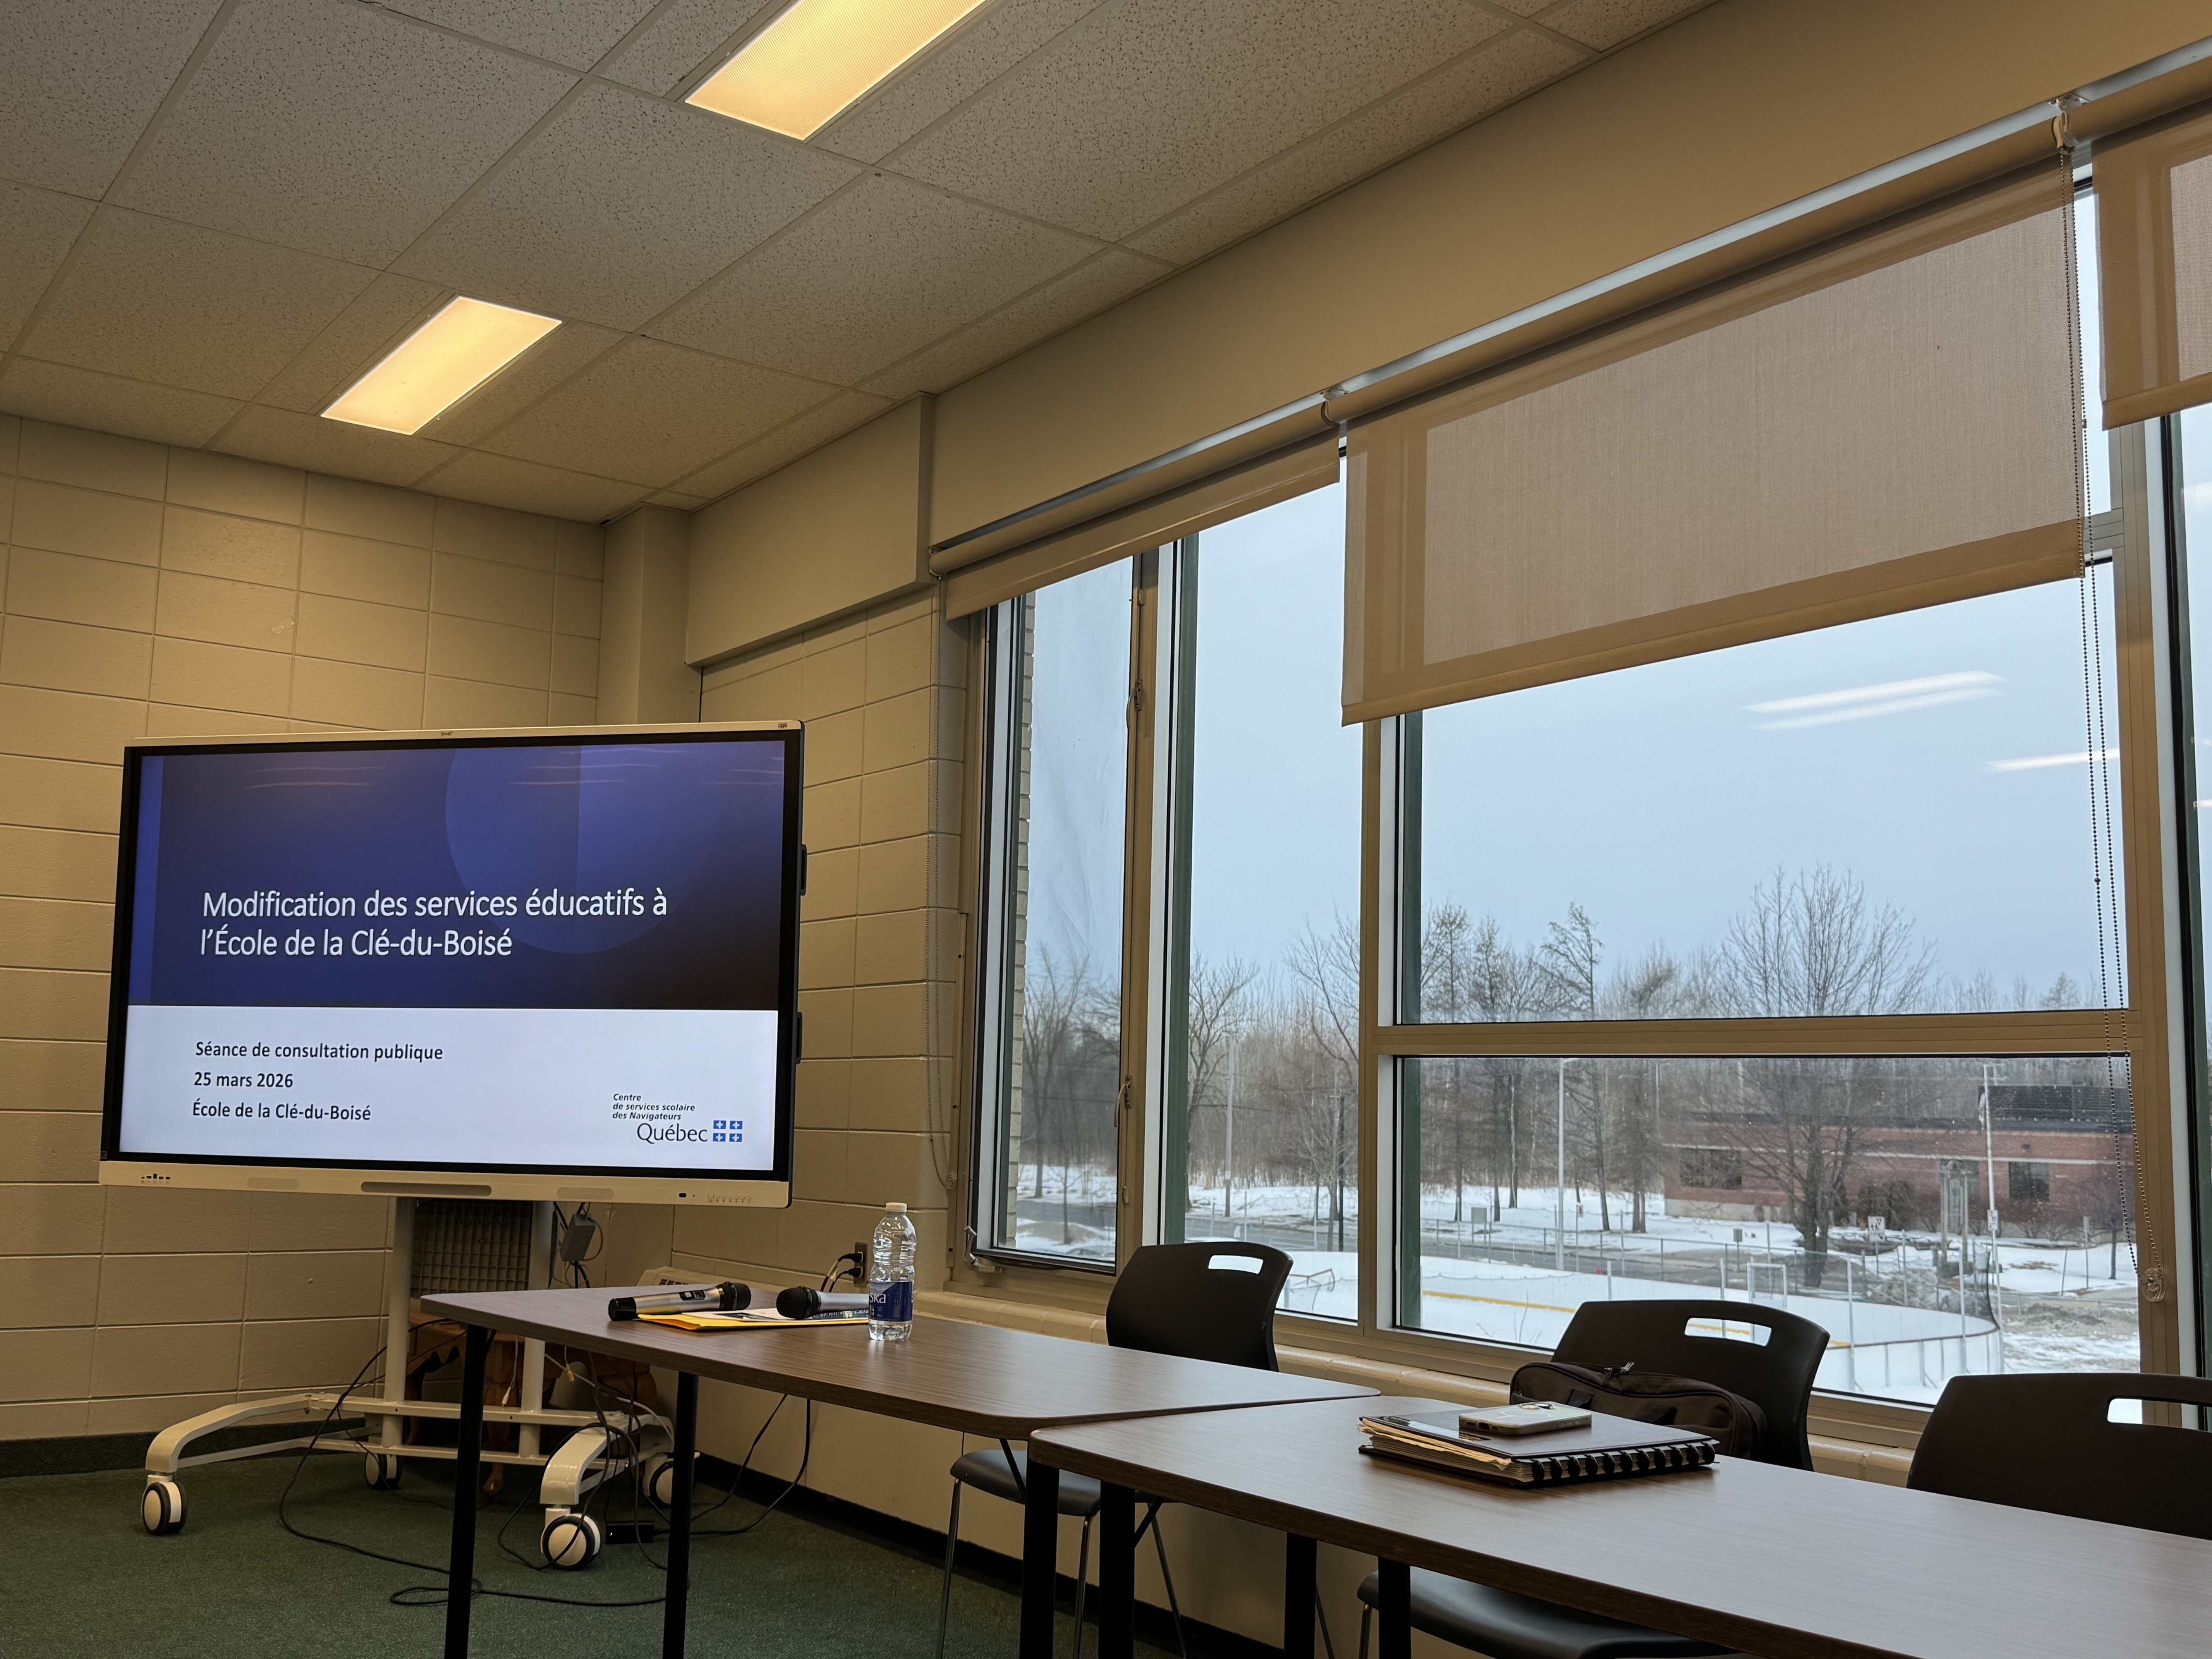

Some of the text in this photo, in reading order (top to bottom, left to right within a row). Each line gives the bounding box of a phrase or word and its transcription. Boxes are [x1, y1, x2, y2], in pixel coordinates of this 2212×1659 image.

[204, 887, 667, 917] Modification des services éducatifs à
[285, 928, 315, 956] de
[323, 928, 343, 956] la
[352, 927, 512, 956] Clé-du-Boisé
[196, 1041, 443, 1063] Séance de consultation publique
[194, 1072, 293, 1088] 25 mars 2026
[613, 1093, 641, 1101] Centre
[193, 1098, 371, 1120] École de la Clé-du-Boisé
[612, 1111, 682, 1121] des Navigateurs
[625, 1103, 659, 1111] services
[637, 1123, 708, 1144] Québec
[870, 1292, 886, 1304] ska
